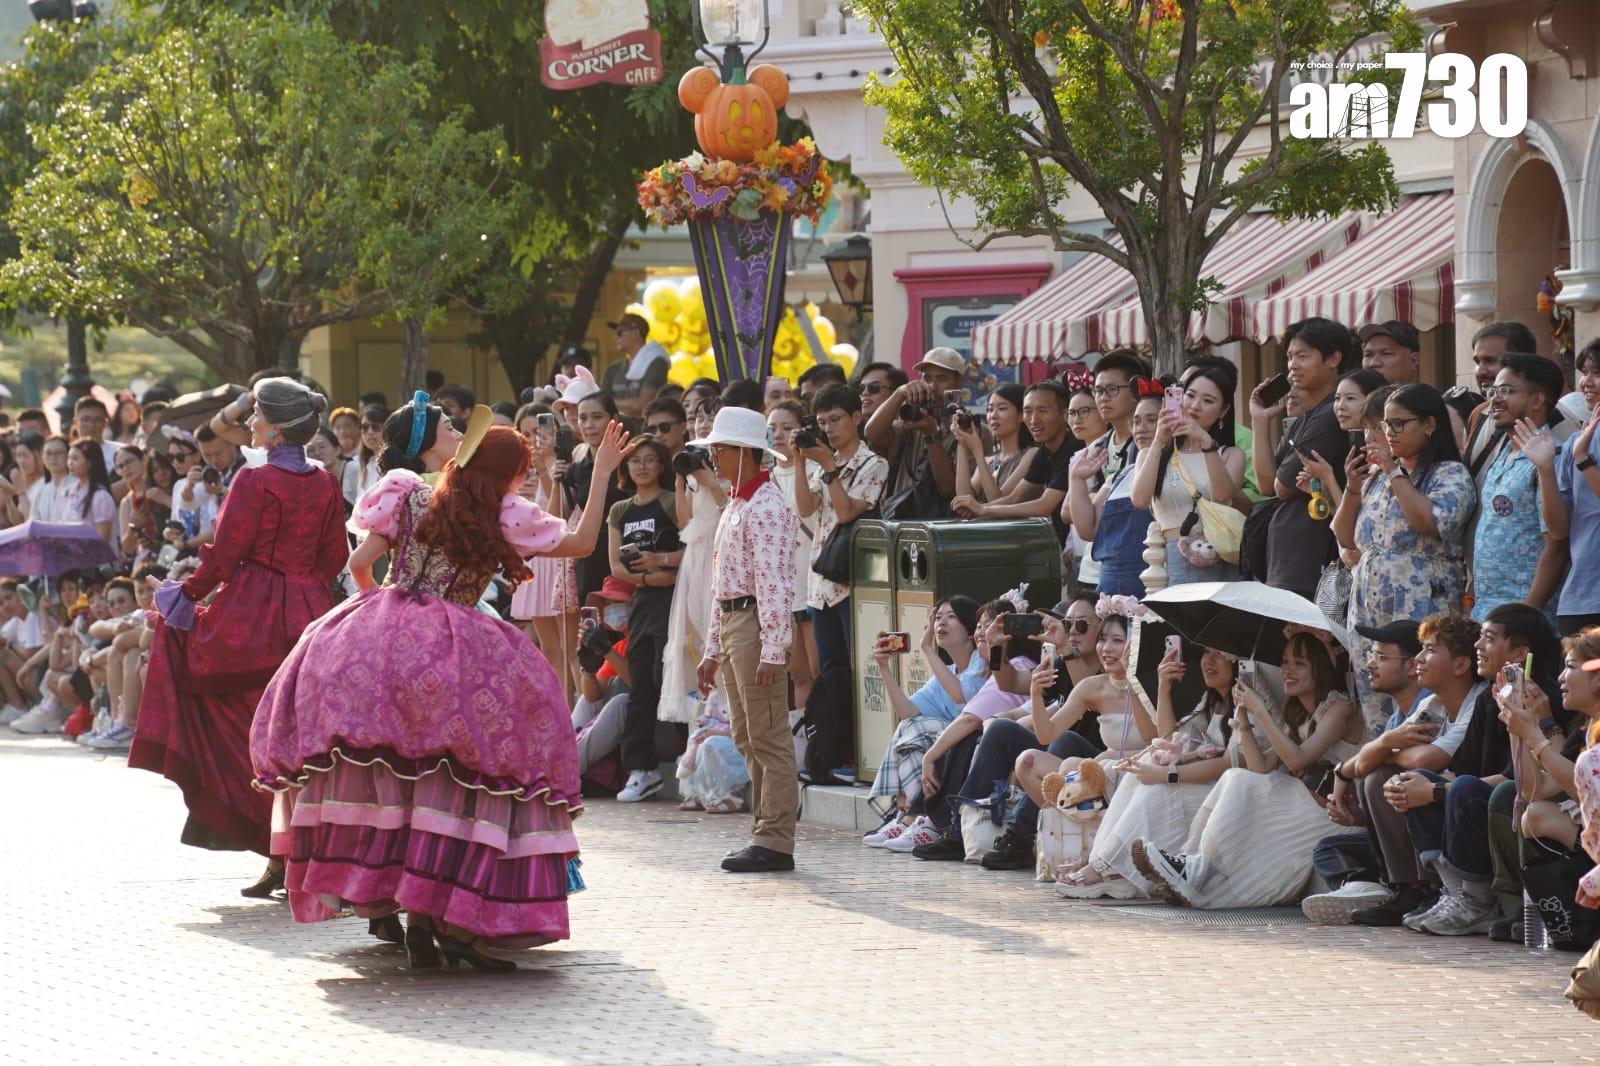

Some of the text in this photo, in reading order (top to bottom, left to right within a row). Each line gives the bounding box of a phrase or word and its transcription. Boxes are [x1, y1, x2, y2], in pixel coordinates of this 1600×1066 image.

[571, 40, 622, 61] MAIN STREET
[548, 43, 652, 80] CORNER
[625, 66, 657, 83] CAFE
